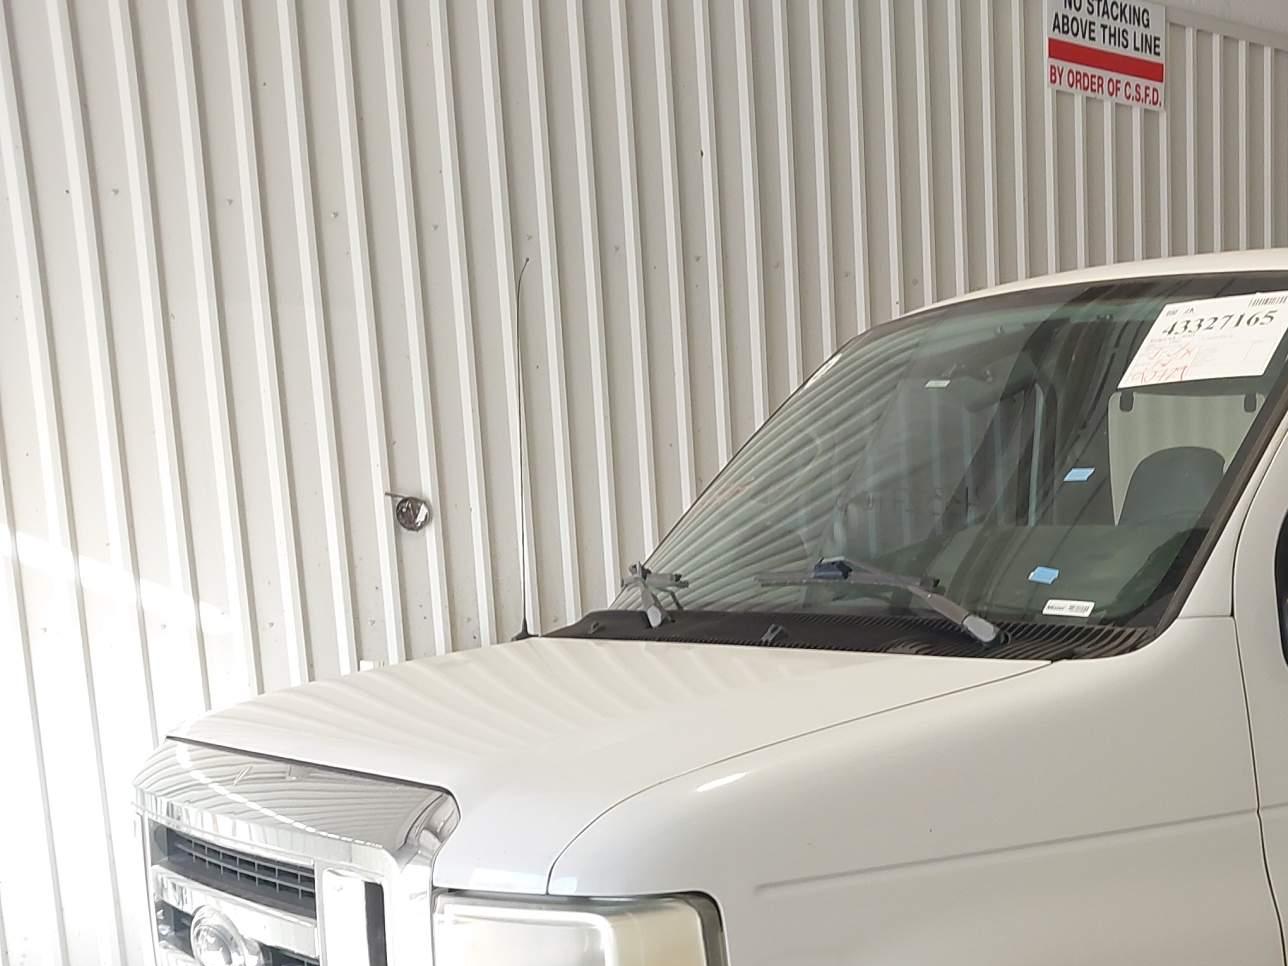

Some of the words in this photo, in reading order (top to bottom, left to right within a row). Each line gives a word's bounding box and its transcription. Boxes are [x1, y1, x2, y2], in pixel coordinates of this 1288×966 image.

[1064, 0, 1082, 12] NO
[1087, 0, 1150, 28] STACKING
[1052, 12, 1096, 42] ABOVE
[1101, 24, 1129, 49] THIS
[1133, 32, 1161, 57] LINE
[1050, 65, 1064, 86] BY
[1067, 69, 1104, 95] ORDER
[1107, 77, 1121, 97] OF
[1124, 82, 1162, 106] C.S.F.D.
[1162, 309, 1279, 337] 43327165
